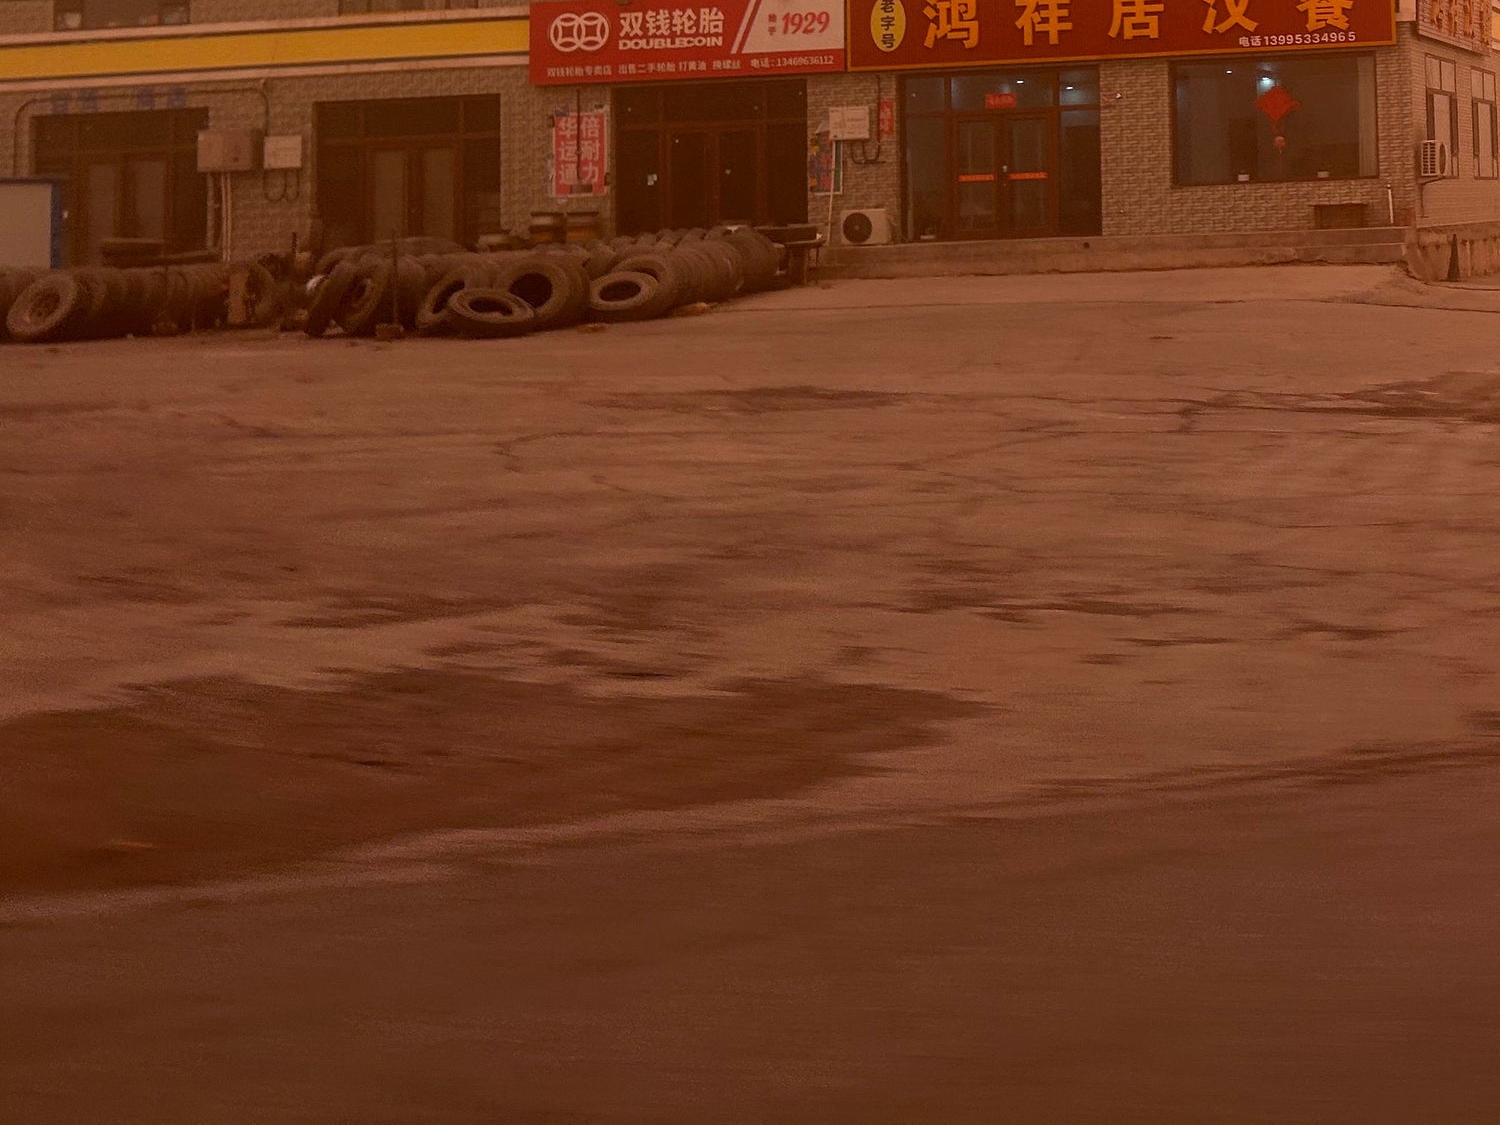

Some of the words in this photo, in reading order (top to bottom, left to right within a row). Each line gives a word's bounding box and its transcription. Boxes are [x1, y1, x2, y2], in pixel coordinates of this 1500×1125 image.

[619, 7, 725, 37] 双钱轮胎
[782, 11, 830, 35] 1929
[618, 35, 723, 51] DOUBLECOIN
